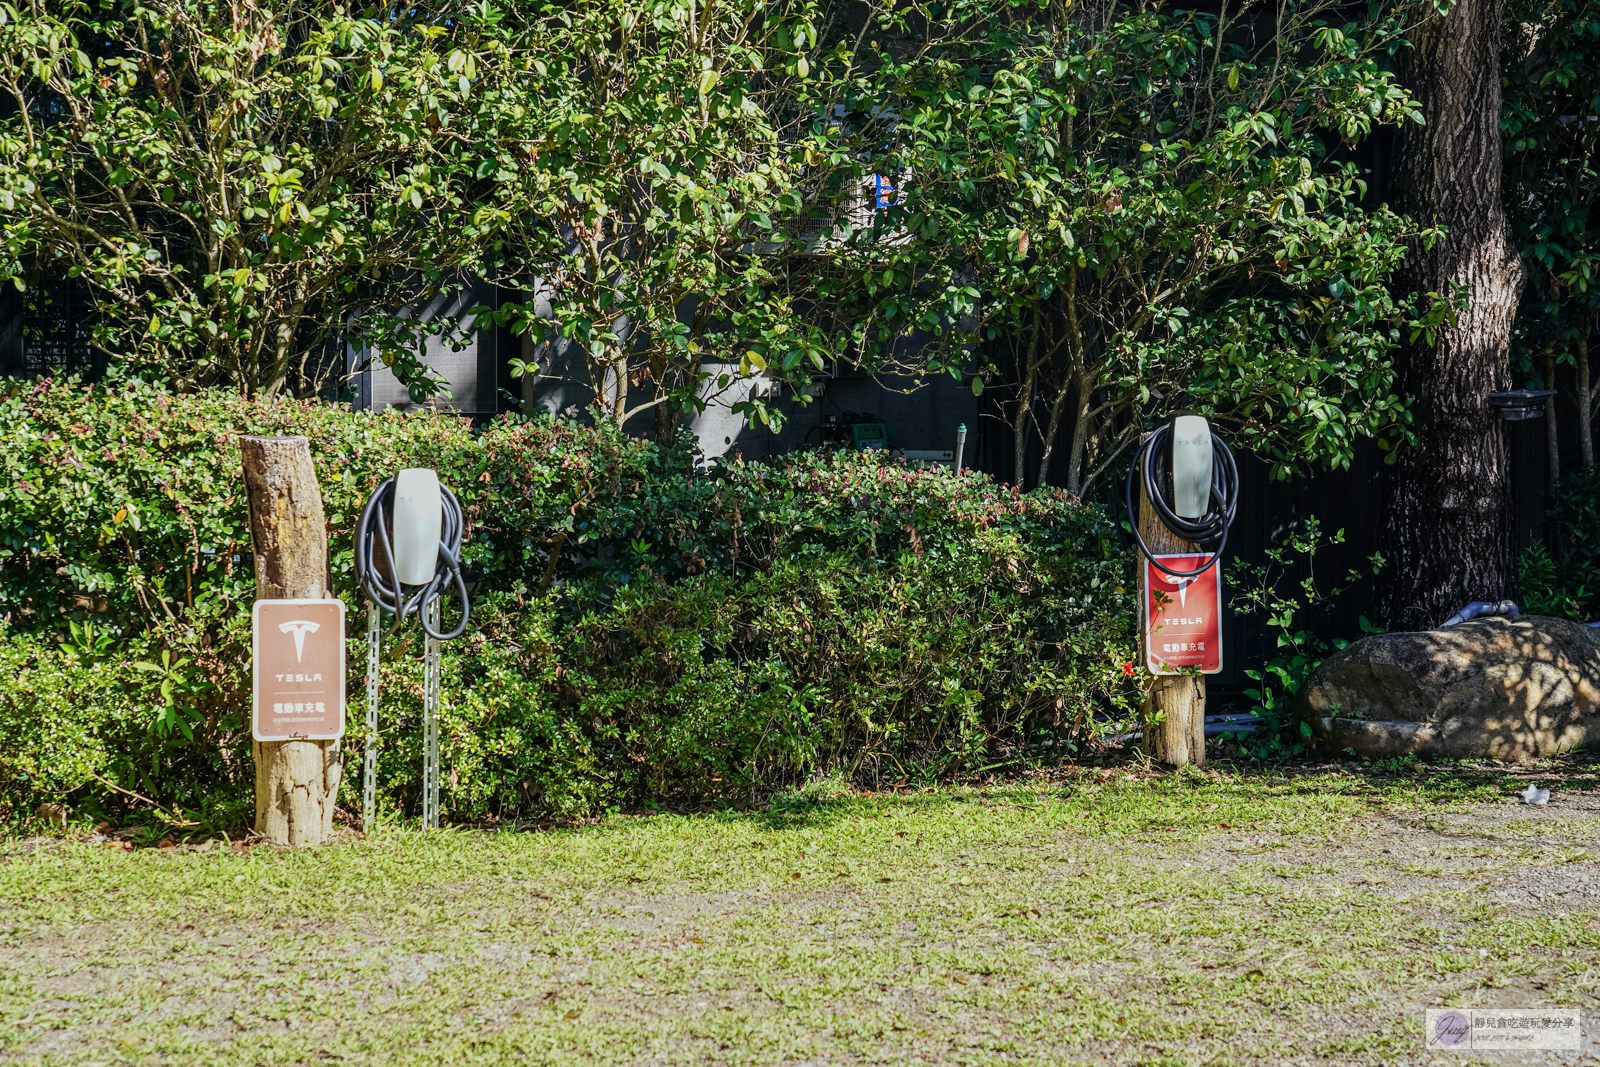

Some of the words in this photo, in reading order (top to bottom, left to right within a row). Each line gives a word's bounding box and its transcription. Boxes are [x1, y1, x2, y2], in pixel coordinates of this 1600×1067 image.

[1164, 617, 1203, 626] TESLA
[1162, 642, 1206, 653] 電動車充電
[275, 674, 322, 682] TESLA
[273, 702, 325, 714] 電動車充電
